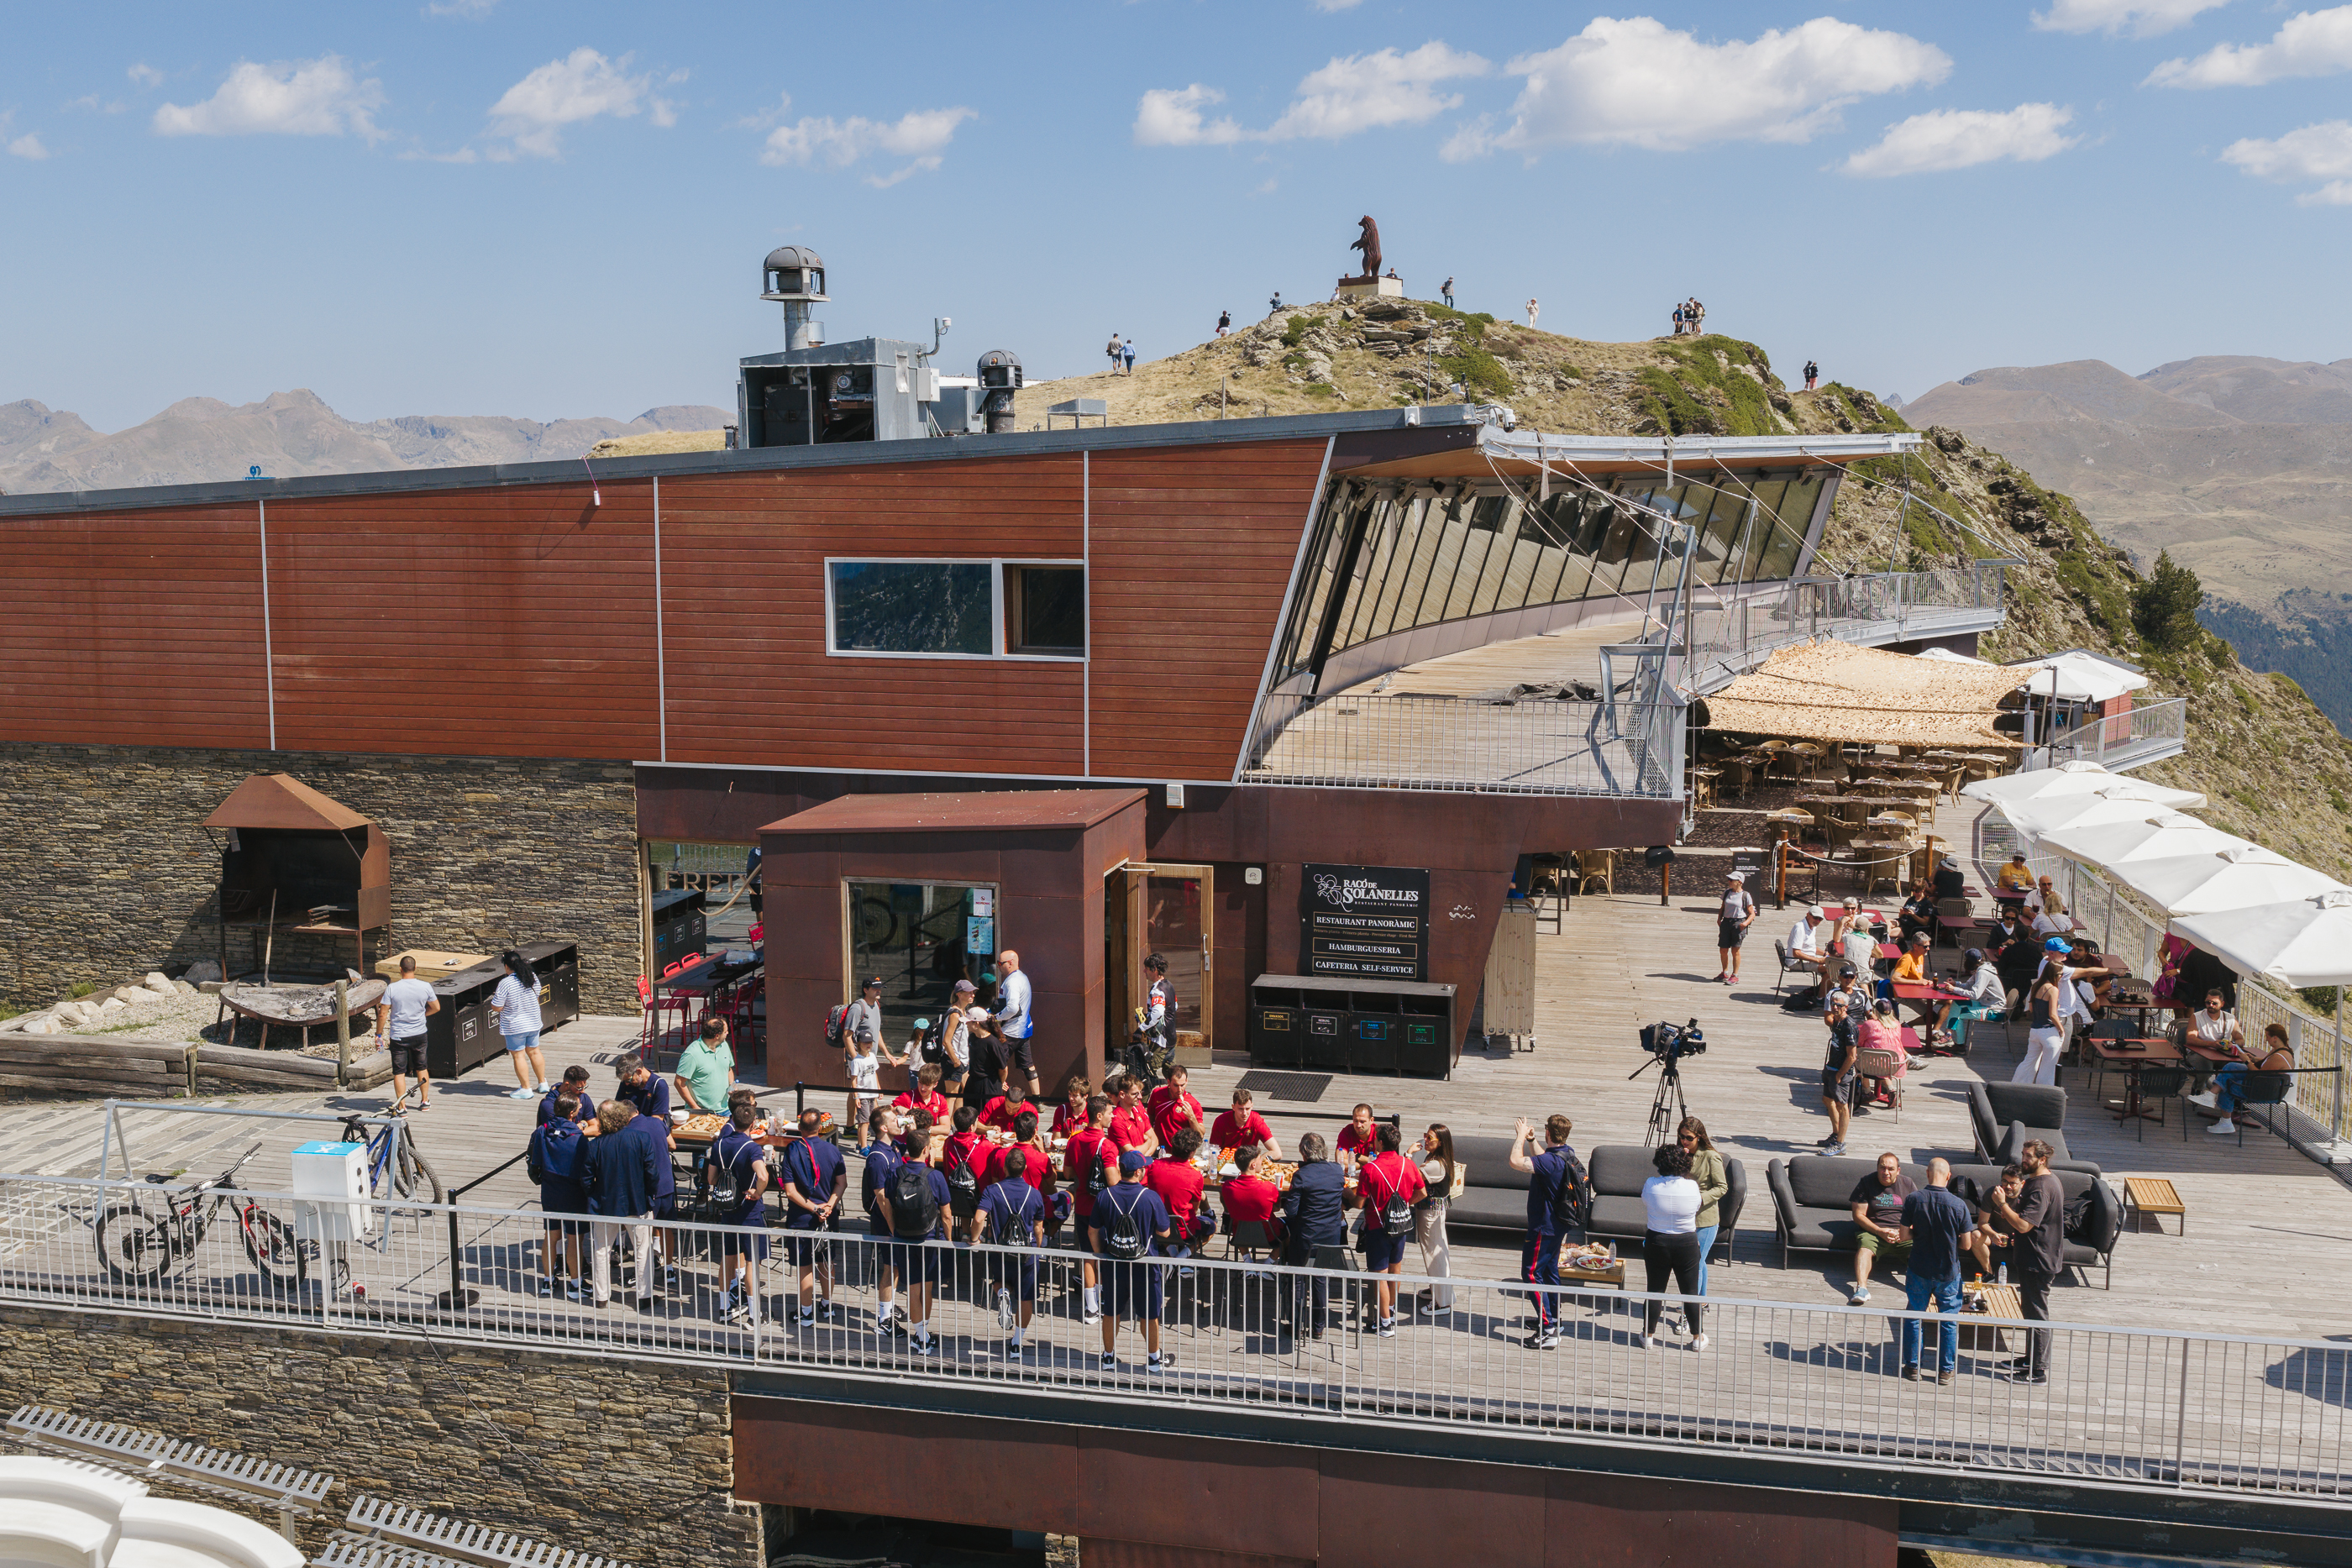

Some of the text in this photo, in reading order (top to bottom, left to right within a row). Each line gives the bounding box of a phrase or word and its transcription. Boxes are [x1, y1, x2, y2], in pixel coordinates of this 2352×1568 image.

[664, 864, 762, 913] FREIX
[1343, 878, 1368, 889] RACÓ
[1342, 888, 1419, 904] SOLANELLES
[1316, 916, 1415, 929] RESTAURANT PANORÀMIC
[1328, 942, 1401, 954] HAMBURGUESERIA
[1315, 961, 1414, 973] CAFETERIA SELF-SERVICE
